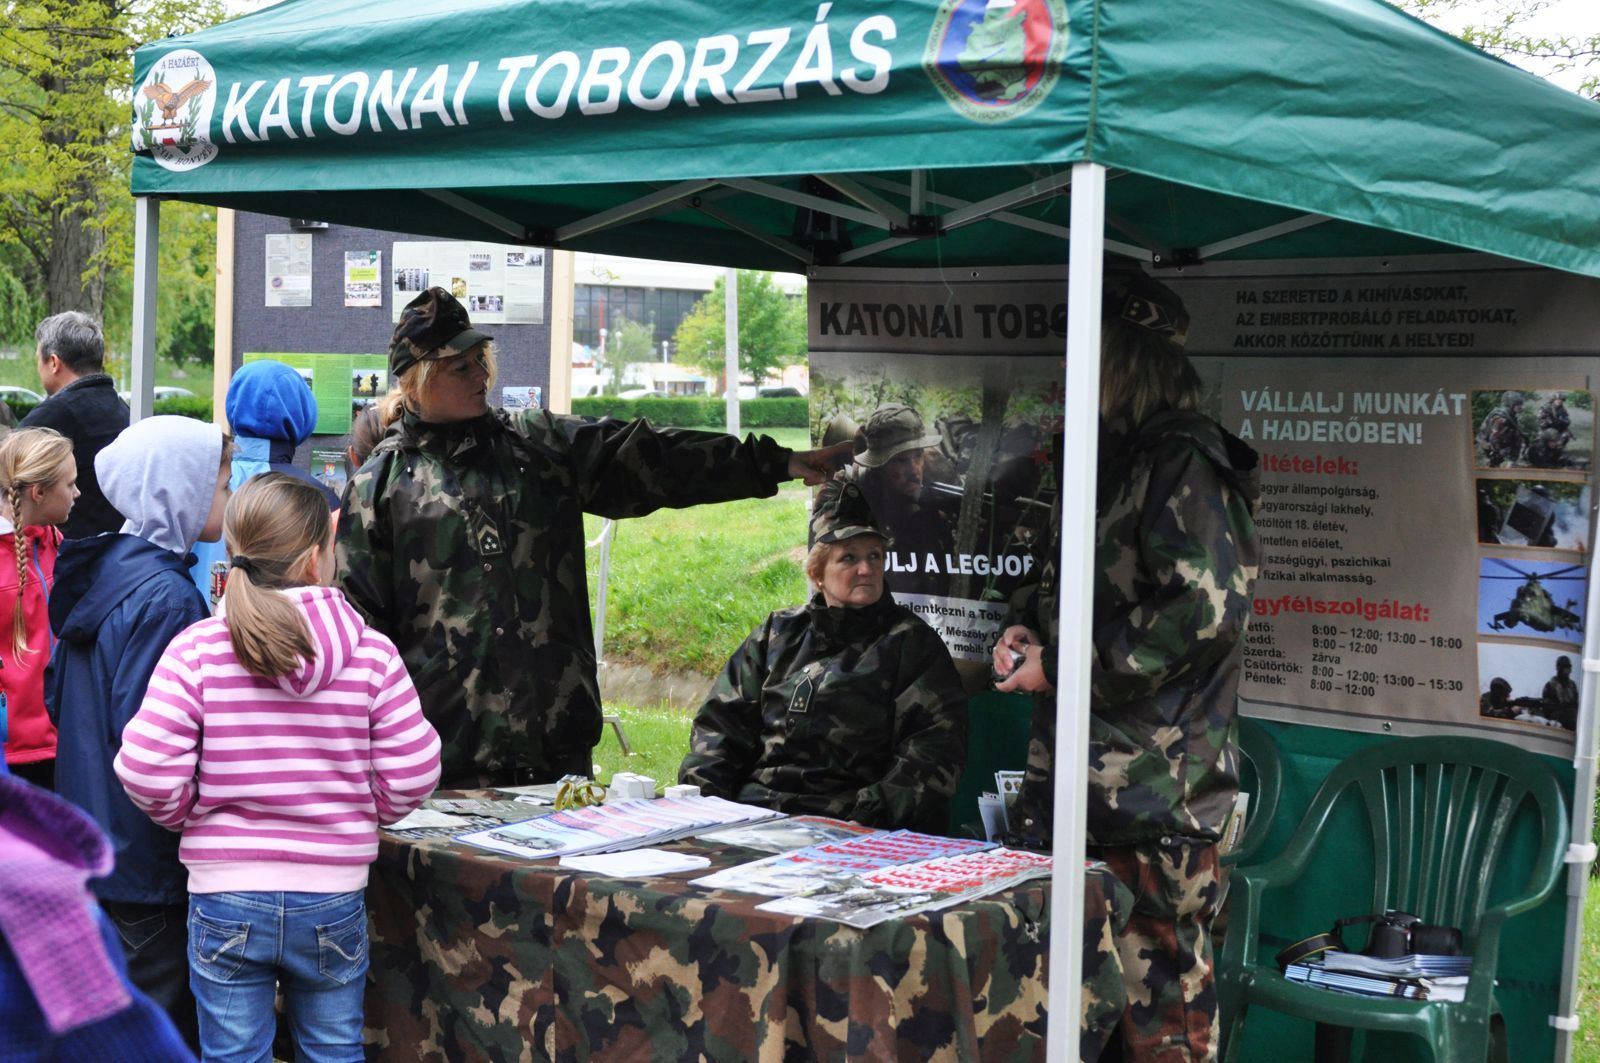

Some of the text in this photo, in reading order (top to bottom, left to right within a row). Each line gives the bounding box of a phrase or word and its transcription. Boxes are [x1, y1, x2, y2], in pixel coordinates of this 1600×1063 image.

[222, 61, 482, 143] KATONAI
[497, 2, 897, 121] TOBORZÁS
[1236, 286, 1468, 304] HA SZERETED A KIHÍVÁSOKAT,
[820, 302, 964, 338] KATONAI
[1236, 309, 1517, 327] AZ EMBERTPRÓBÁLÓ FELADATOKAT,
[1234, 335, 1286, 348] AKKOR
[1390, 334, 1400, 347] A
[1405, 333, 1475, 348] HELYED!
[1240, 387, 1467, 416] VÁLLALJ MUNKÁT
[1239, 416, 1423, 445] A HADERŐBEN!
[1263, 453, 1360, 475] ltételek:
[1260, 483, 1380, 499] agyar állampolgárság,
[1261, 501, 1374, 517] agyarországi lakhely,
[1254, 518, 1348, 533] etöltött 18. életév,
[925, 552, 940, 573] A
[1331, 556, 1391, 569] pszichikai
[1263, 569, 1296, 581] fizikai
[1299, 571, 1376, 585] alkalmasság.
[968, 610, 976, 619] a
[1253, 595, 1429, 621] gyfélszolgálat:
[946, 626, 988, 642] Mészöly
[1248, 622, 1274, 632] étfő:
[1312, 625, 1337, 636] 8:00
[1387, 631, 1416, 644] 13:00
[1430, 637, 1462, 649] 18:00
[954, 643, 984, 654] mobil:
[1243, 646, 1341, 664] Szerda: zárva
[1313, 638, 1336, 649] 8:00
[1349, 642, 1377, 654] 12:00
[1244, 659, 1303, 674] Csütörtök:
[1312, 666, 1334, 677] 8:00
[1384, 674, 1414, 687] 13:00
[1429, 679, 1463, 691] 15:30
[1245, 671, 1286, 685] Péntek:
[1310, 679, 1332, 691] 8:00
[1345, 684, 1375, 696] 12:00
